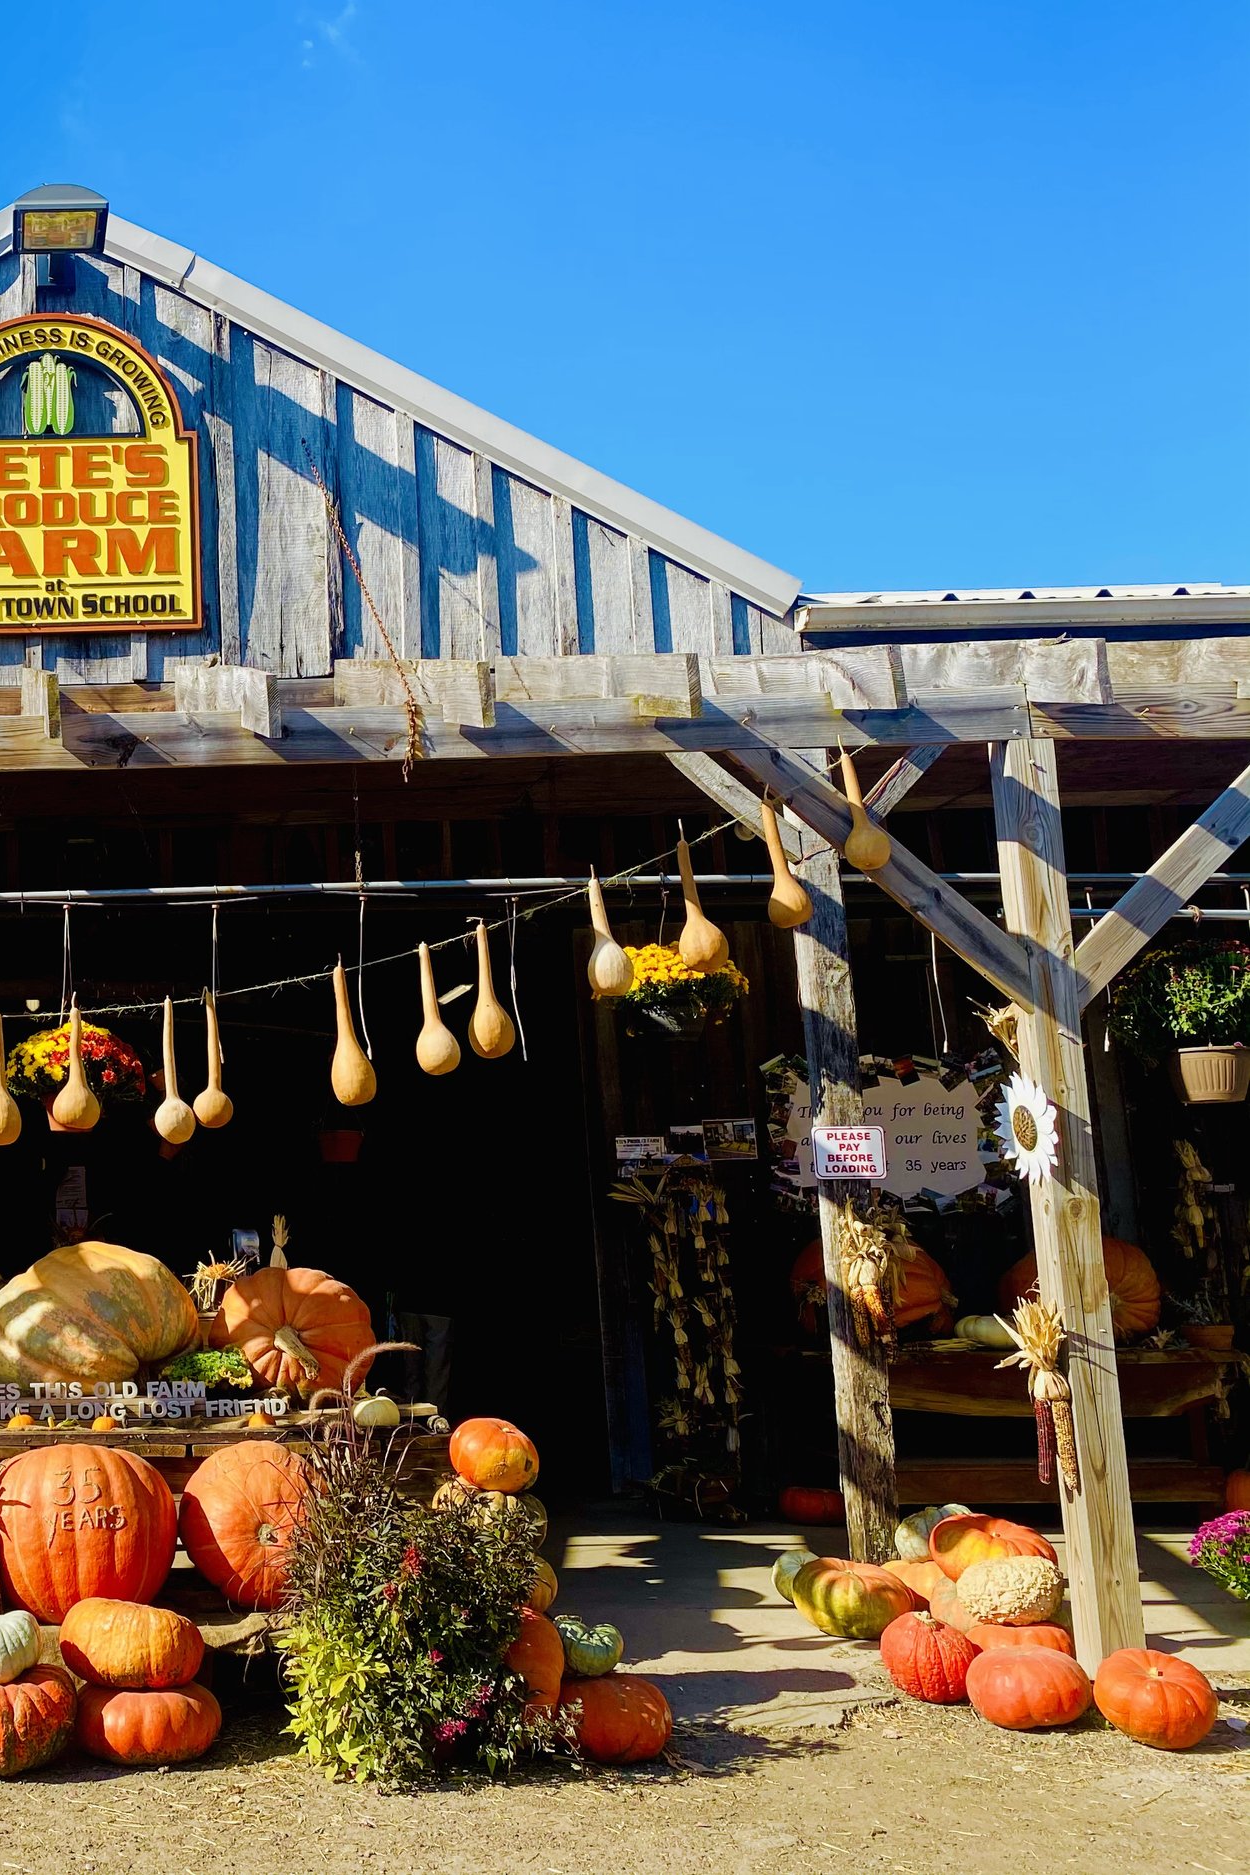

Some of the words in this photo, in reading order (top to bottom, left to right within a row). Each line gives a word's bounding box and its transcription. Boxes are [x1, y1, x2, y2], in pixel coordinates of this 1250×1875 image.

[69, 331, 89, 347] IS
[95, 341, 166, 428] GROWING
[44, 580, 65, 593] at
[81, 593, 182, 616] SCHOOL
[890, 1103, 915, 1122] for
[923, 1103, 965, 1119] being
[826, 1132, 871, 1141] PLEASE
[895, 1134, 922, 1145] our
[932, 1130, 967, 1144] lives
[838, 1143, 860, 1152] PAY
[827, 1154, 873, 1163] BEFORE
[905, 1160, 922, 1172] 35
[931, 1160, 967, 1173] years
[825, 1165, 877, 1174] LOADING
[30, 1382, 83, 1399] THIS
[93, 1382, 138, 1398] OLD
[147, 1382, 206, 1398] FARM
[39, 1403, 56, 1420] A
[65, 1402, 127, 1420] LONG
[139, 1400, 196, 1419] LOST
[205, 1398, 288, 1418] FRIEND
[52, 1465, 103, 1507] 35
[43, 1504, 128, 1549] YEARS
